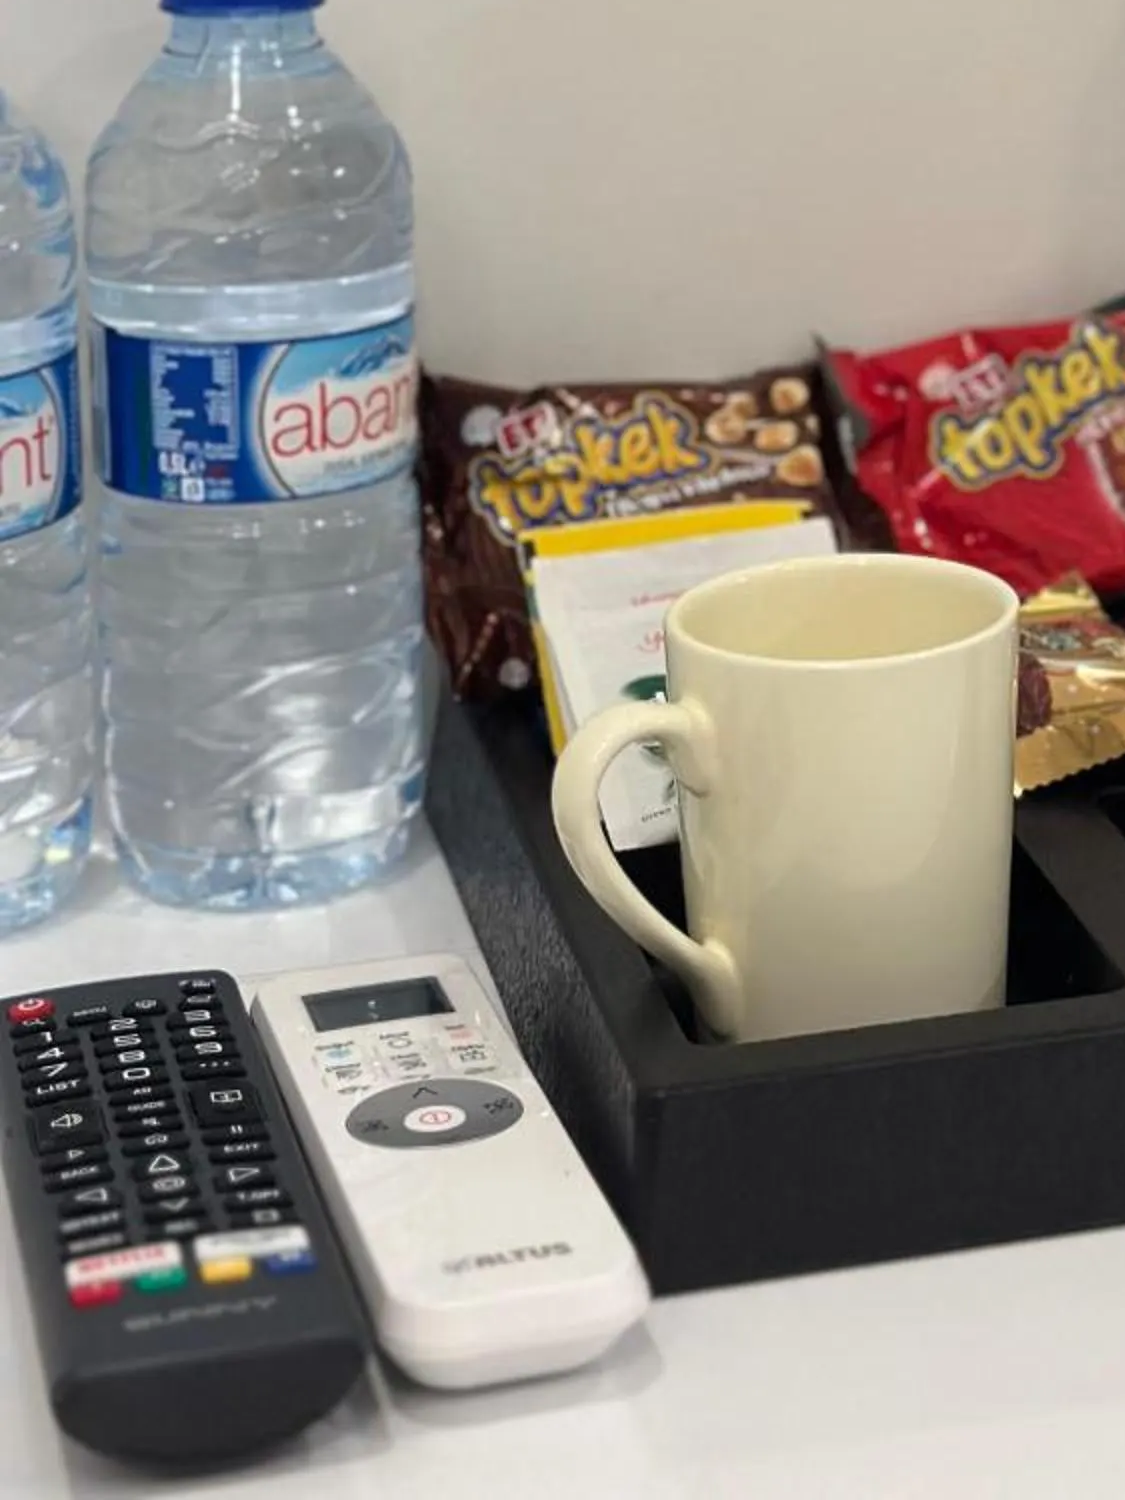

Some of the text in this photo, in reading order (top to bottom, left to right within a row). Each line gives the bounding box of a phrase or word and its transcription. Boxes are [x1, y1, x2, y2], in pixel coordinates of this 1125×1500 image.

[109, 1017, 138, 1031] 2
[36, 1079, 80, 1095] LIST
[60, 1166, 99, 1180] BACK
